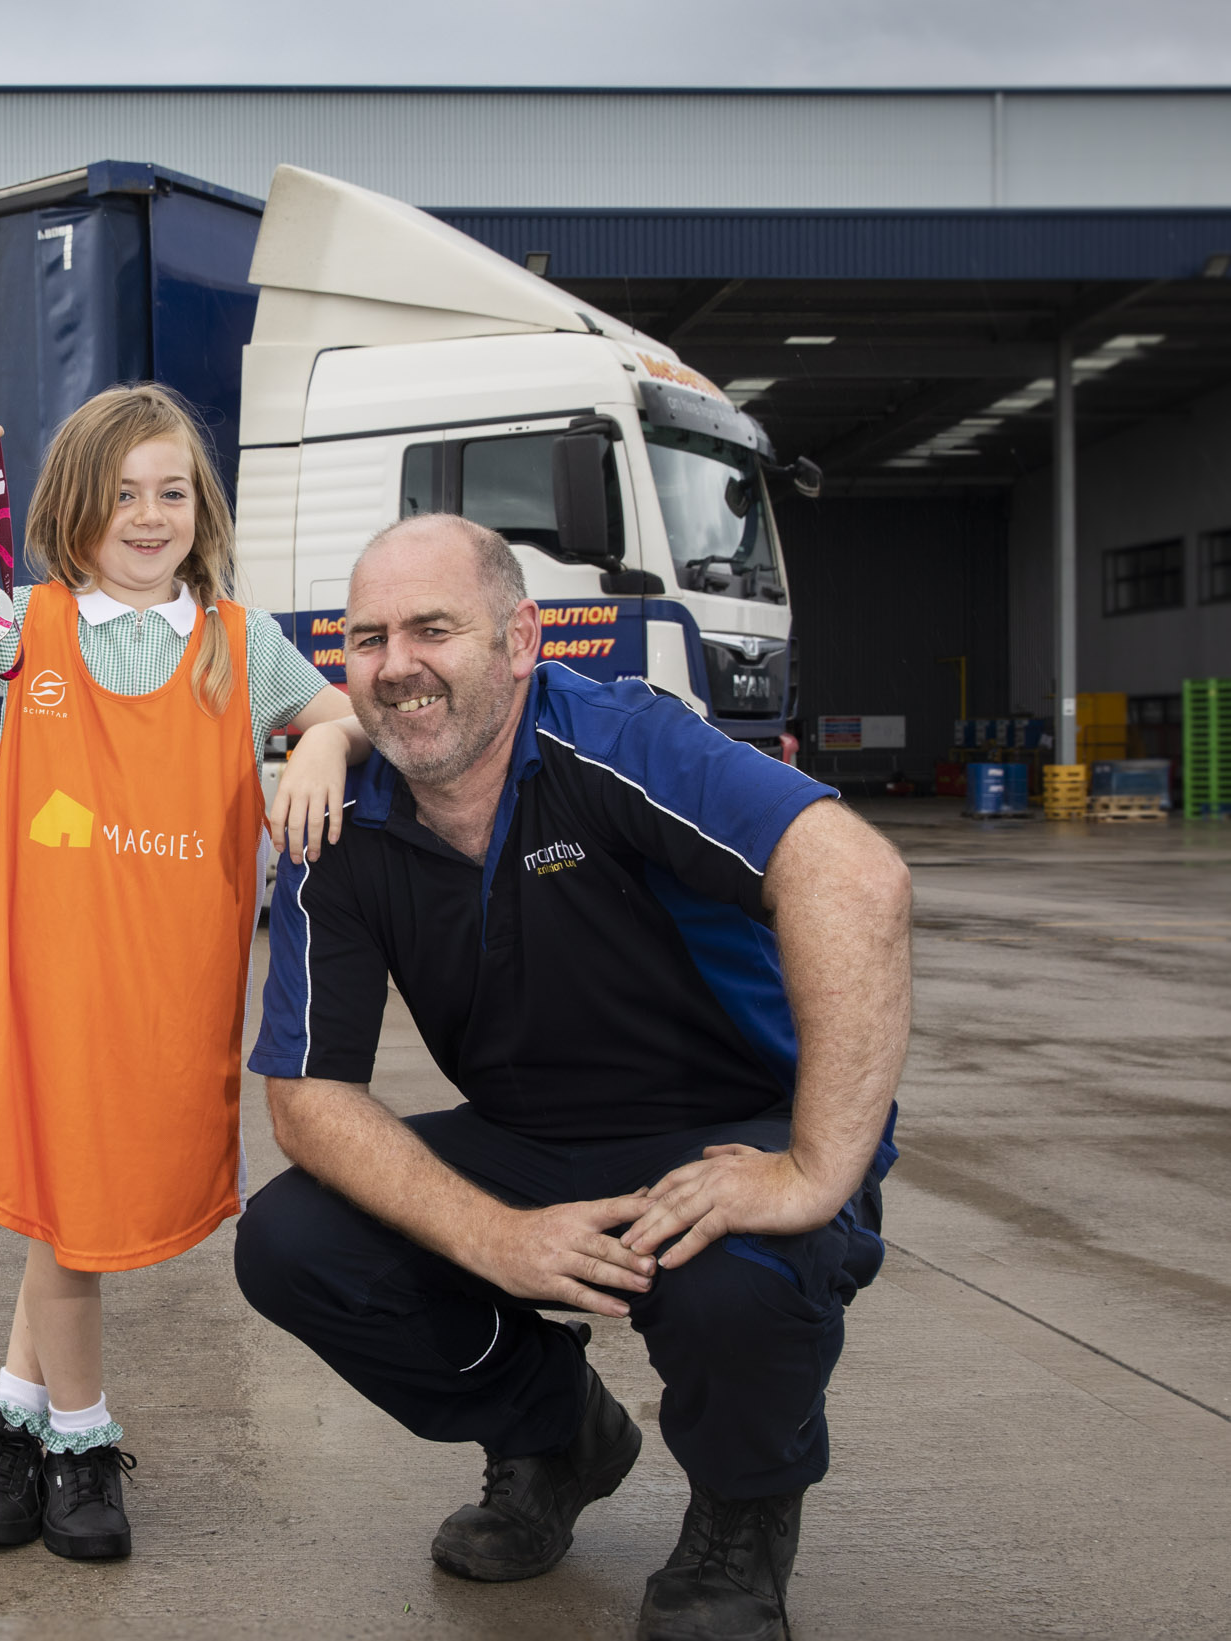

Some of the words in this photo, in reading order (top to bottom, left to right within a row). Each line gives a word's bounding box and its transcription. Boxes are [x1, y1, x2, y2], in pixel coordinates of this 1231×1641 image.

[539, 605, 618, 627] IBUTION
[541, 638, 616, 660] 664977
[733, 673, 769, 698] MAN
[23, 706, 68, 719] SCIMITAR
[103, 824, 204, 860] MAGGIE'S
